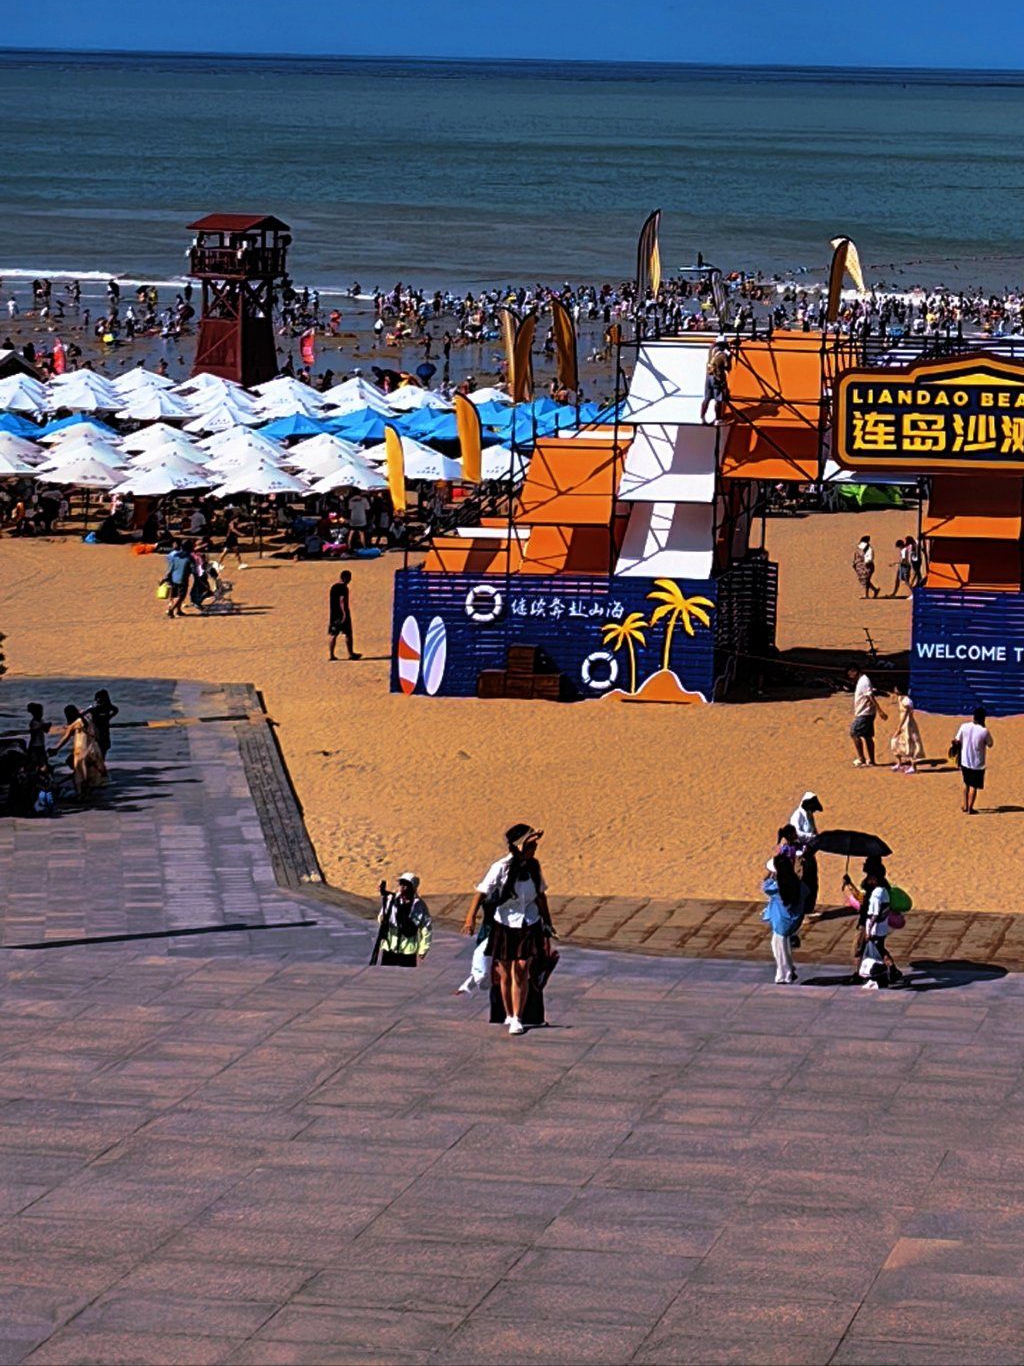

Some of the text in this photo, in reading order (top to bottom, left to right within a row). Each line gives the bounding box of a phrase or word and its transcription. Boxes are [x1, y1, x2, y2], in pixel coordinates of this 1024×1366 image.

[852, 388, 969, 407] LIANDAO
[511, 597, 625, 620] 继续奔赴山海
[916, 643, 1006, 661] WELCOME
